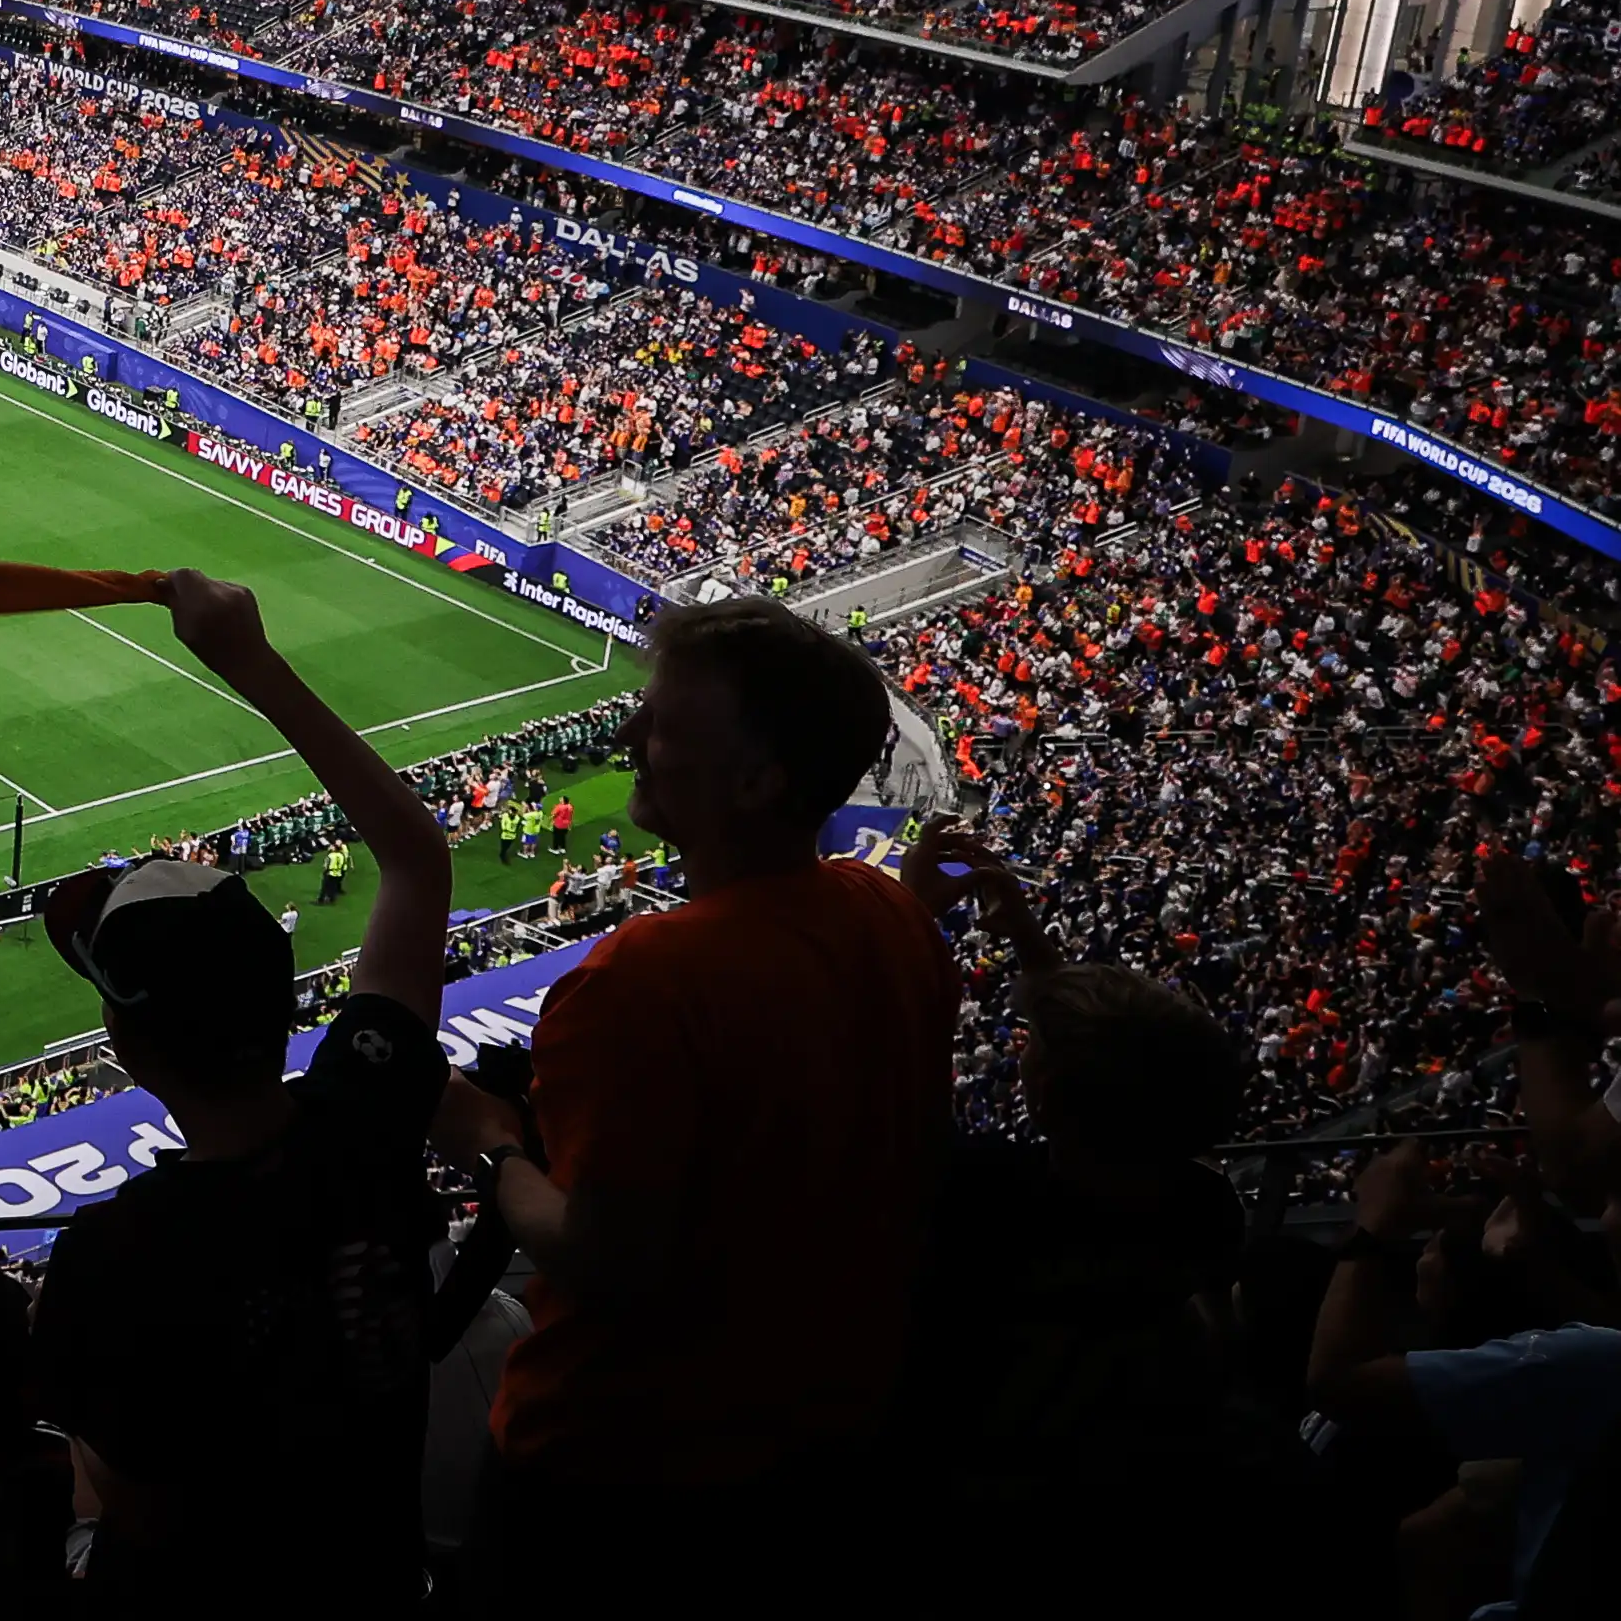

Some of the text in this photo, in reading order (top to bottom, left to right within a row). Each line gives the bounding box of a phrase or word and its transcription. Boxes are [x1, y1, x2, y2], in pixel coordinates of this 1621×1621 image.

[138, 32, 240, 71] FIFA WORLD CUP 2026
[48, 60, 106, 92] WORLD
[106, 77, 139, 100] CUP
[140, 90, 201, 121] 2026
[399, 106, 444, 129] DALLAS
[1007, 295, 1074, 329] DALLAS
[0, 351, 66, 395] Globant
[86, 390, 159, 438] Globant
[1371, 418, 1544, 516] FIFA WORLD CUP 2026
[198, 437, 425, 550] SAVVY GAMES GROUP
[474, 539, 507, 567] FIFA
[520, 577, 561, 609] Inter
